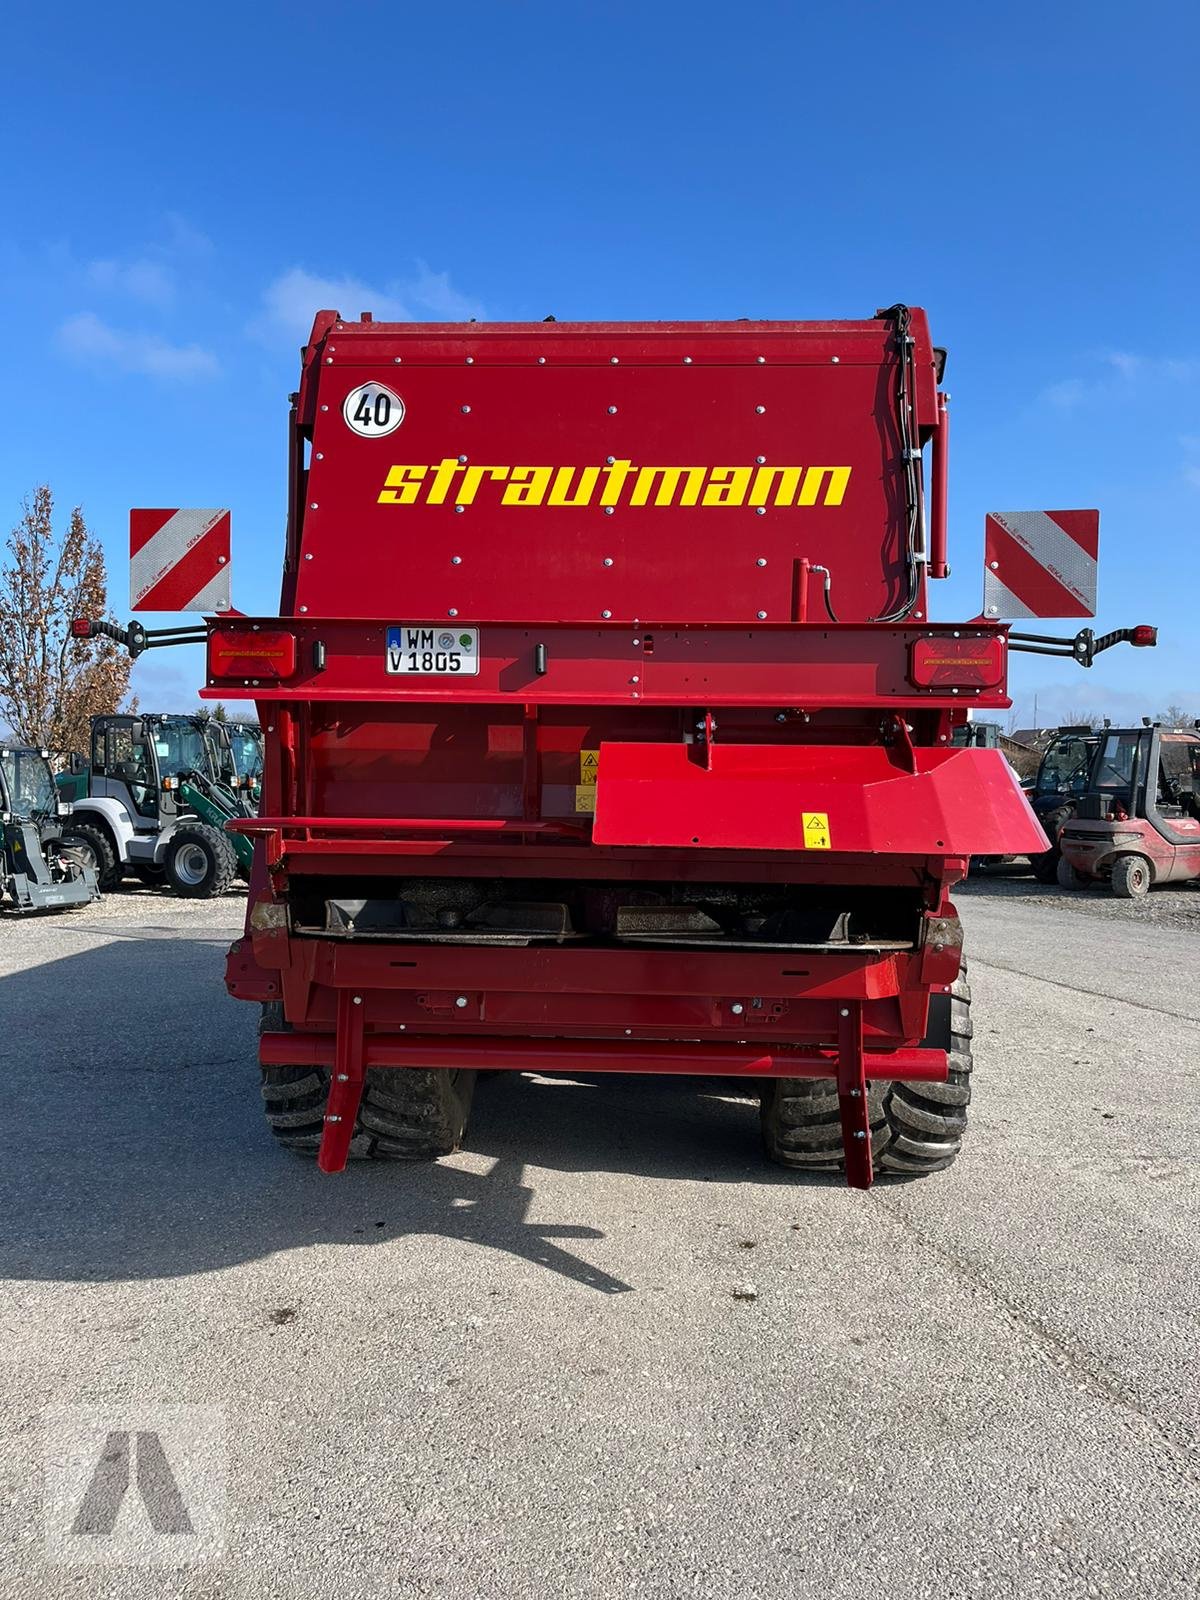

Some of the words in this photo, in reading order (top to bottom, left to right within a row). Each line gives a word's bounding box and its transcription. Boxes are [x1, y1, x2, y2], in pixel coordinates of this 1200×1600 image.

[353, 393, 391, 427] 40
[377, 458, 852, 507] strautmann
[186, 534, 201, 549] GEKA
[407, 629, 434, 650] WM
[390, 651, 402, 671] V
[408, 651, 461, 671] 1805
